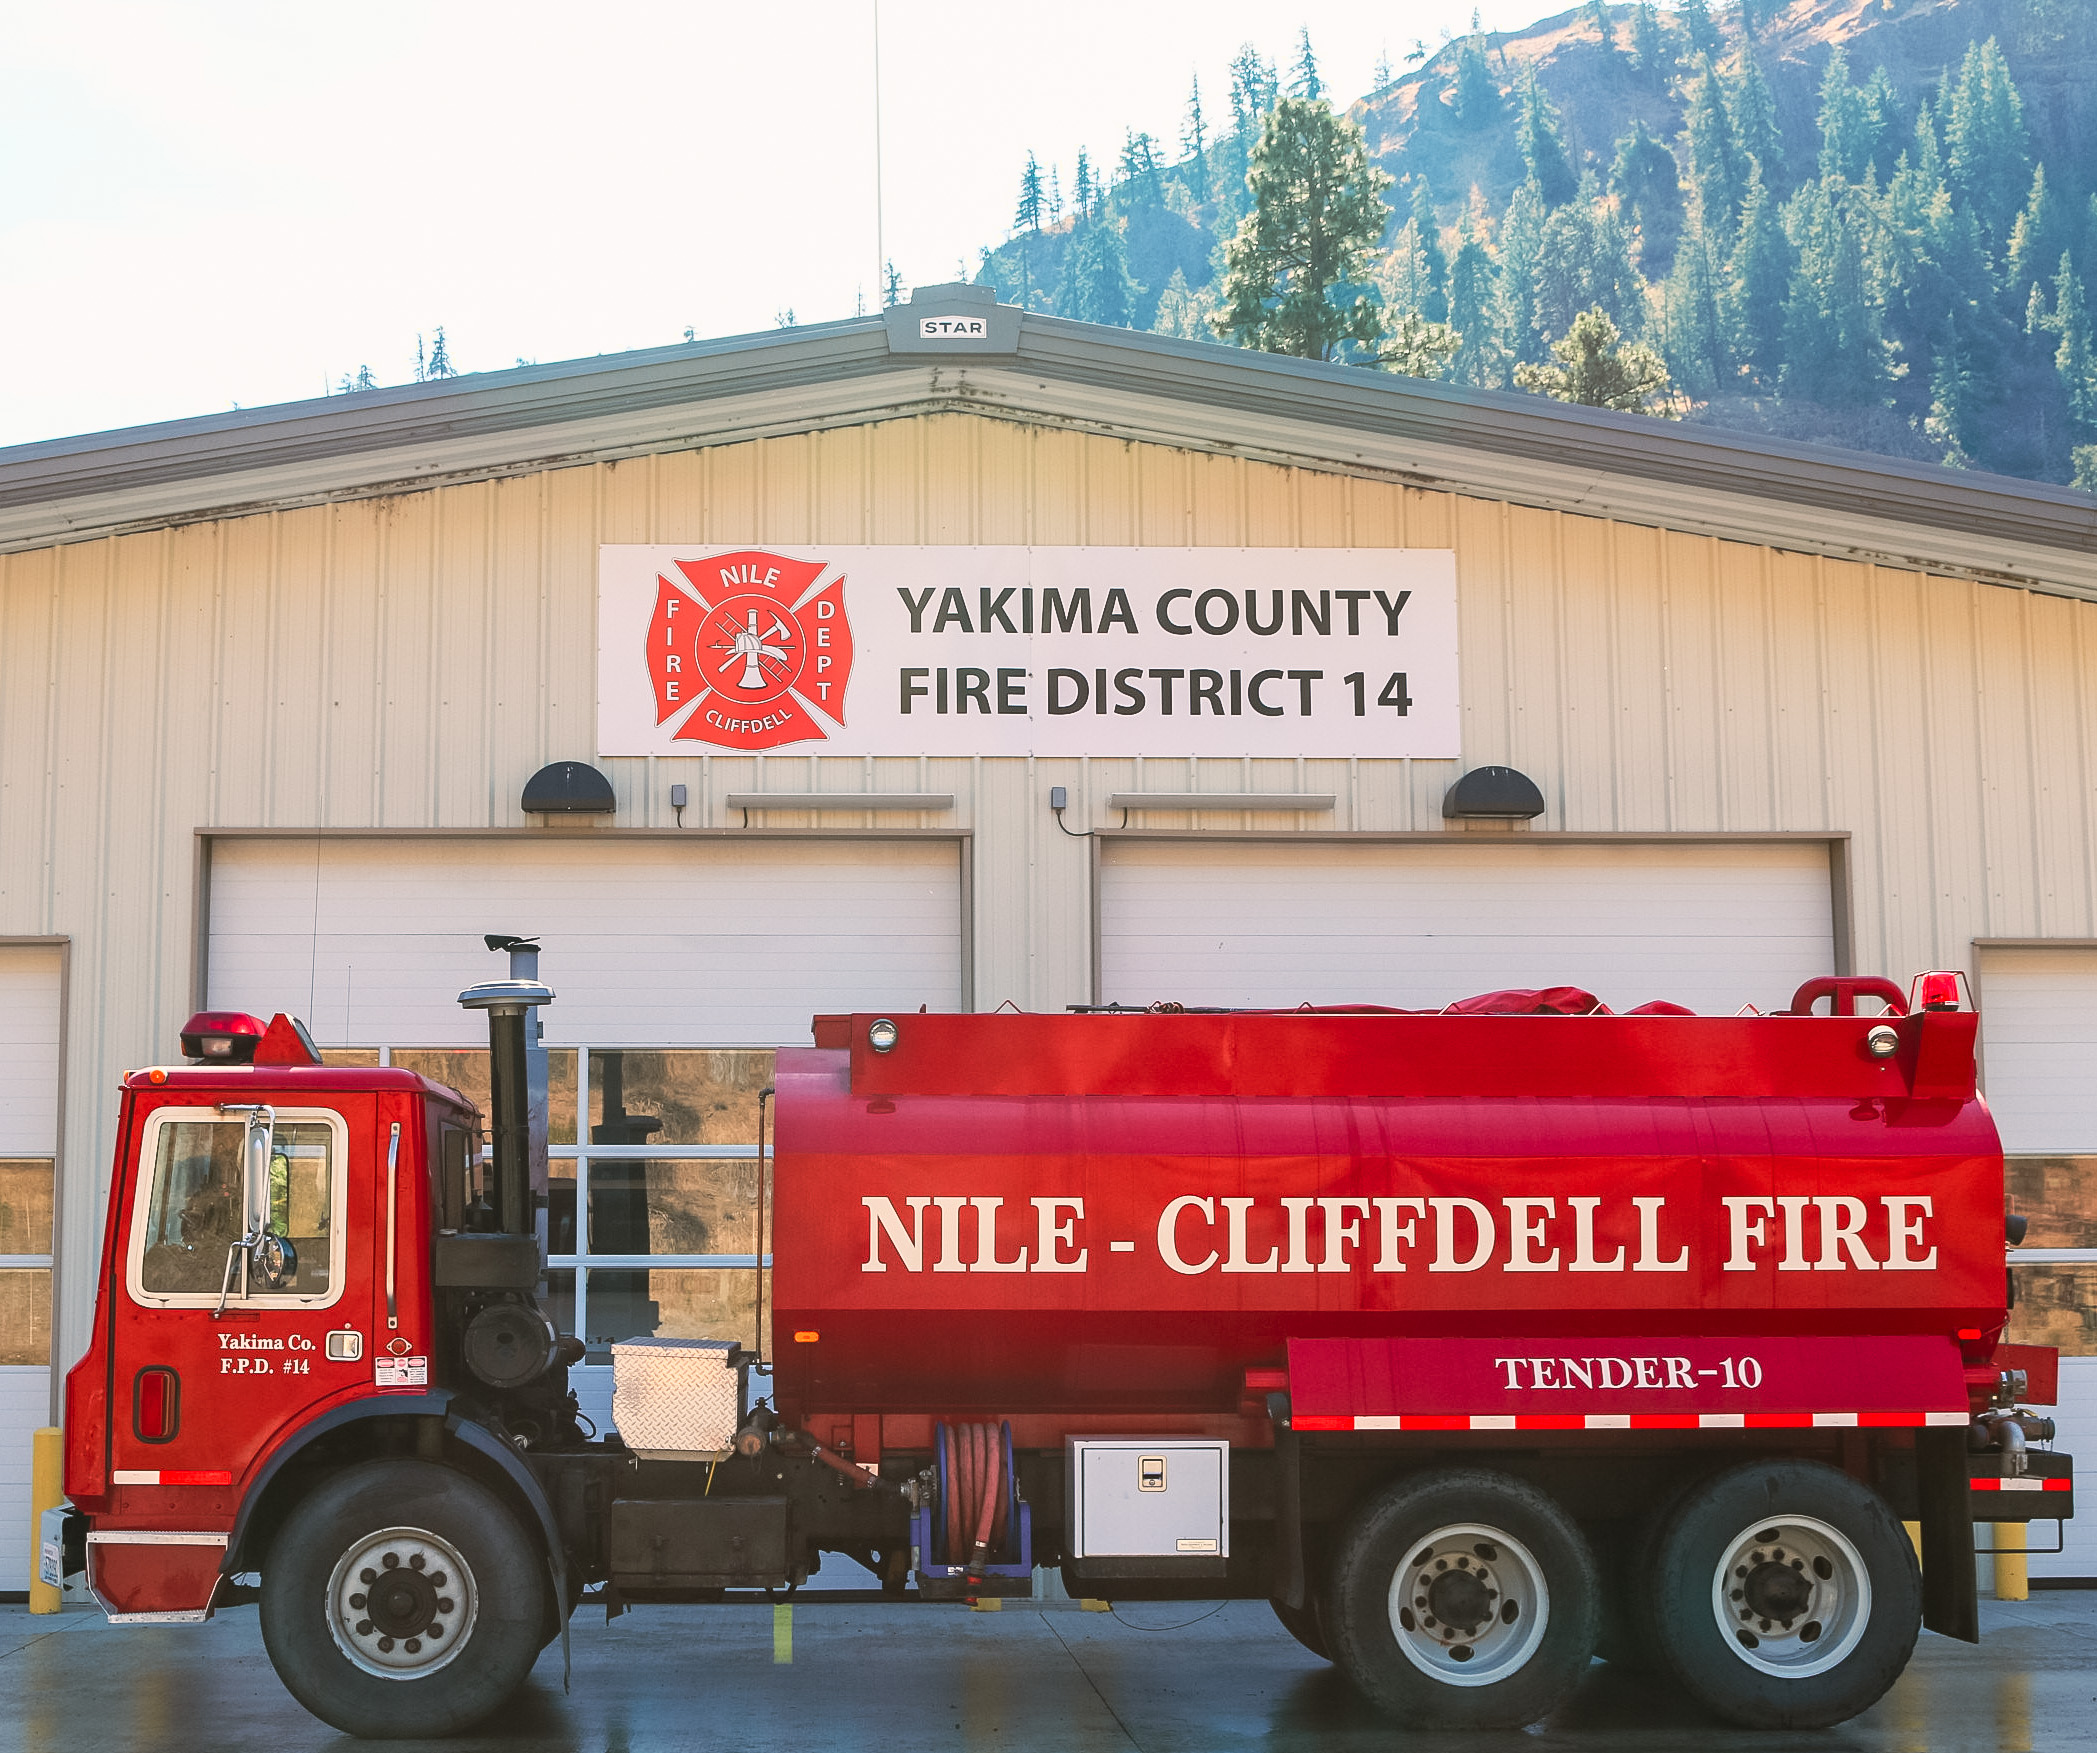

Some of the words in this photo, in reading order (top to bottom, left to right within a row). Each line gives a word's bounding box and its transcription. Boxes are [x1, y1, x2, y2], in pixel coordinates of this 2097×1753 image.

[924, 321, 982, 333] STAR
[719, 564, 781, 589] NILE
[896, 587, 1139, 634] YAKIMA
[1155, 588, 1412, 636] COUNTY
[666, 599, 682, 701] FIRE
[816, 600, 836, 701] DEPT
[900, 667, 1028, 714] FIRE
[1048, 667, 1324, 716] DISTRICT
[1343, 671, 1413, 716] 14
[705, 708, 793, 734] CLIFFDELL
[861, 1196, 1088, 1273] NILE
[1156, 1195, 1689, 1275] CLIFFDELL
[1722, 1196, 1938, 1271] FIRE
[217, 1333, 285, 1350] Yakima
[288, 1334, 316, 1350] Co.
[220, 1358, 274, 1374] F.P.D.
[283, 1358, 310, 1375] #14
[1495, 1357, 1763, 1390] TENDER-10
